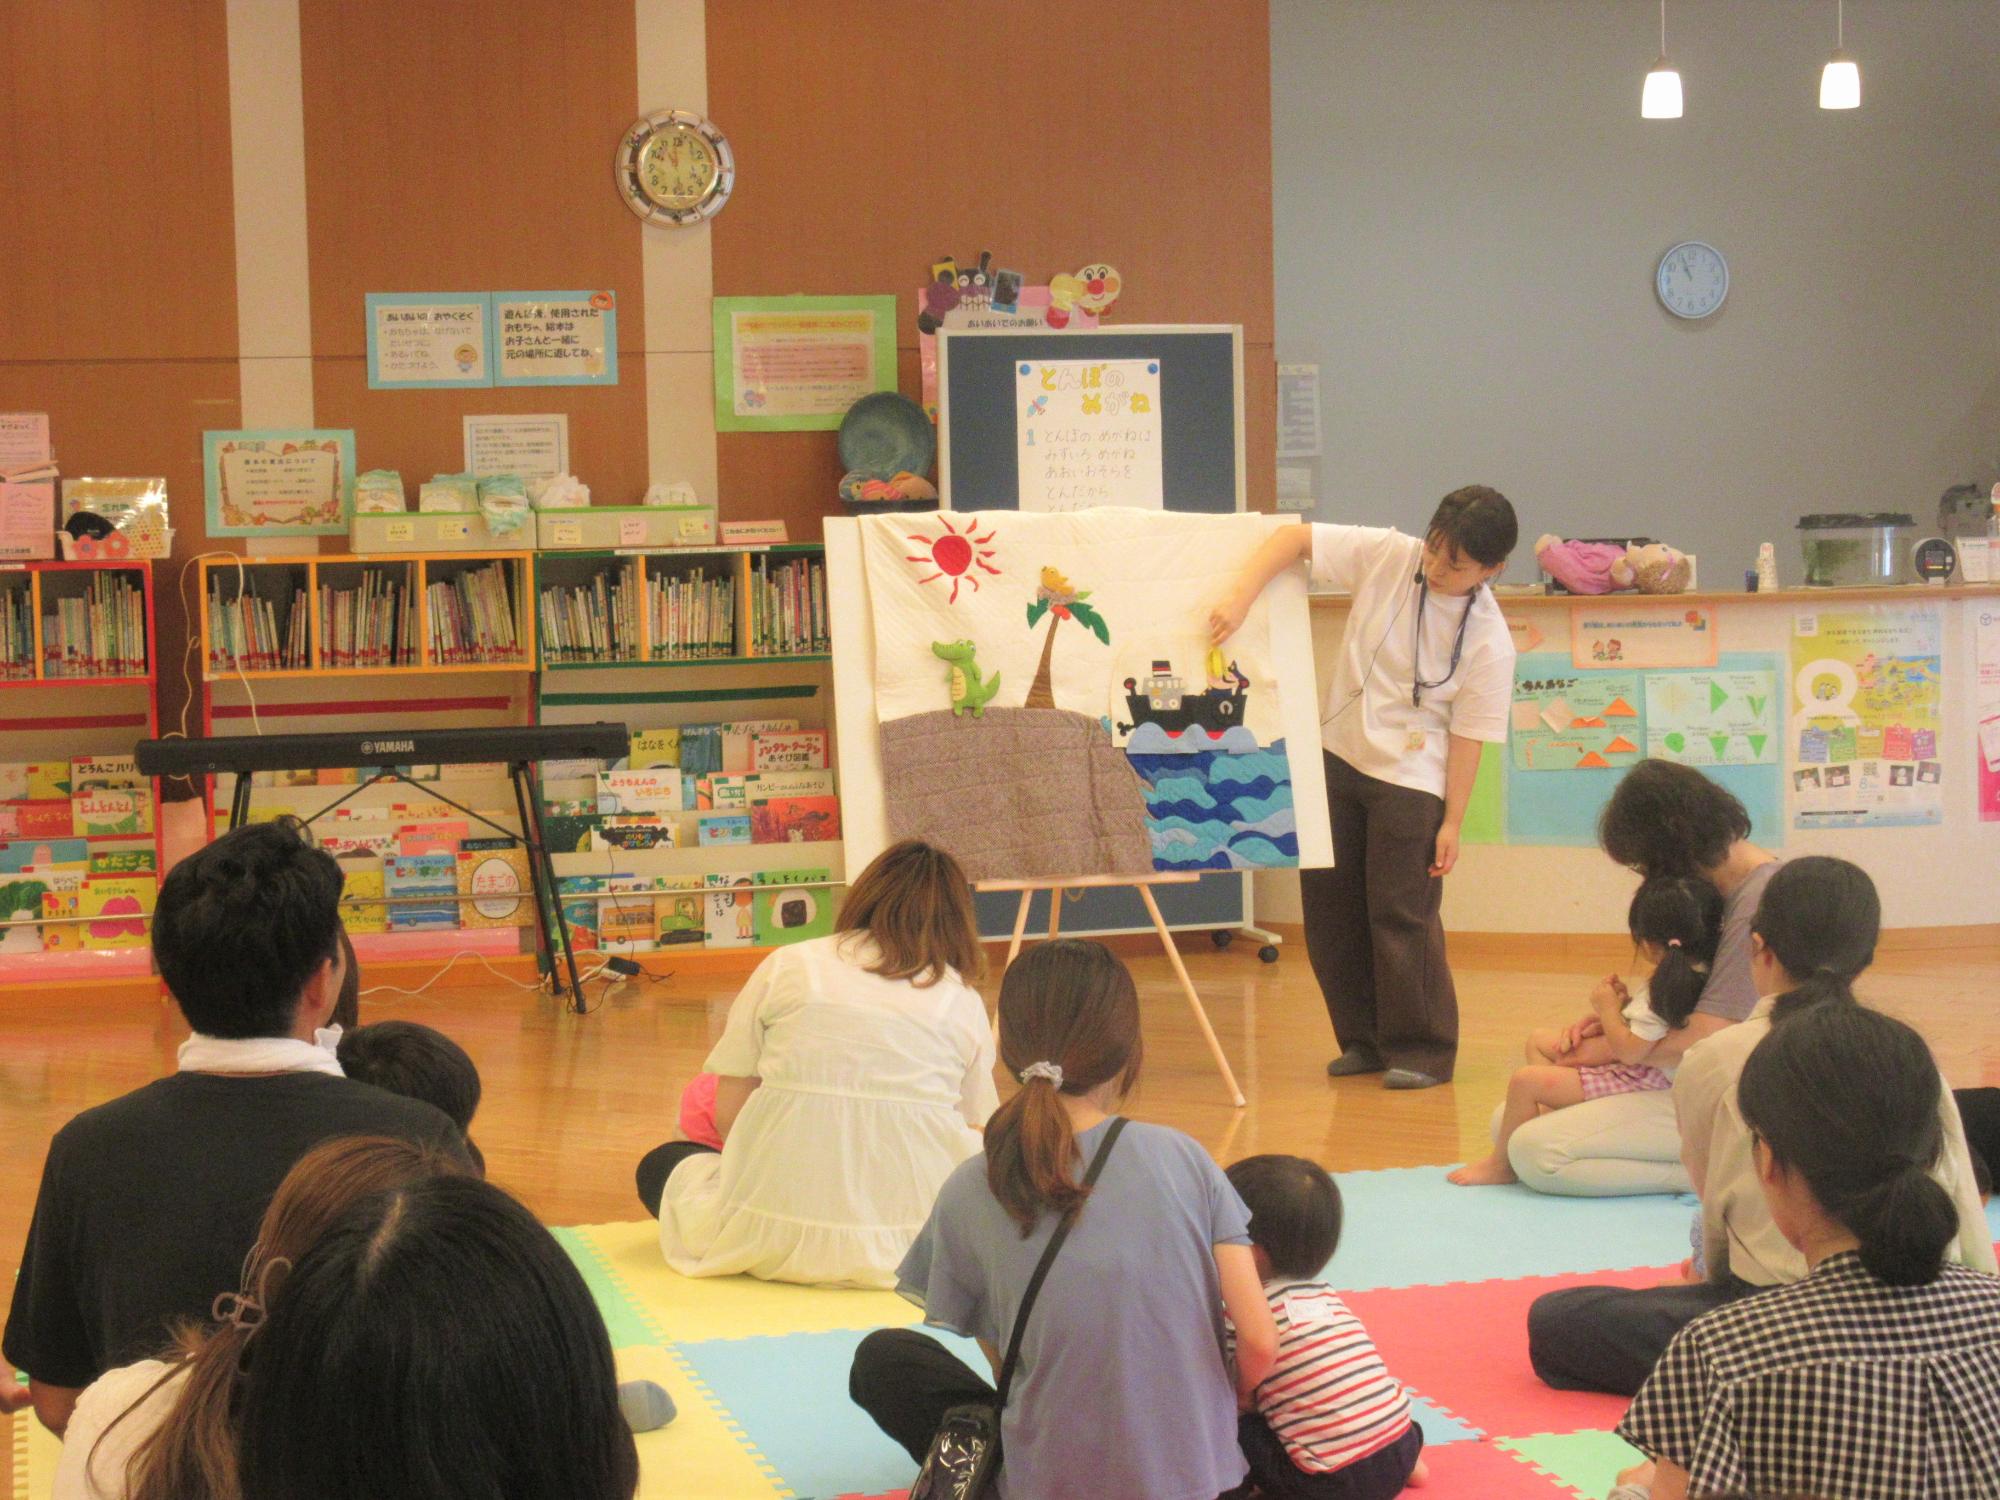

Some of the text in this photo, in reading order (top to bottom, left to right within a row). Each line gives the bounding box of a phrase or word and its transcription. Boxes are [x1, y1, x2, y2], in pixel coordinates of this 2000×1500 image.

[1040, 364, 1125, 391] とんぼの
[1082, 391, 1151, 416] めがね
[1026, 429, 1036, 446] 1
[374, 740, 415, 752] YAMAHA
[78, 763, 135, 773] どろんこハリ
[476, 872, 518, 889] たまごの
